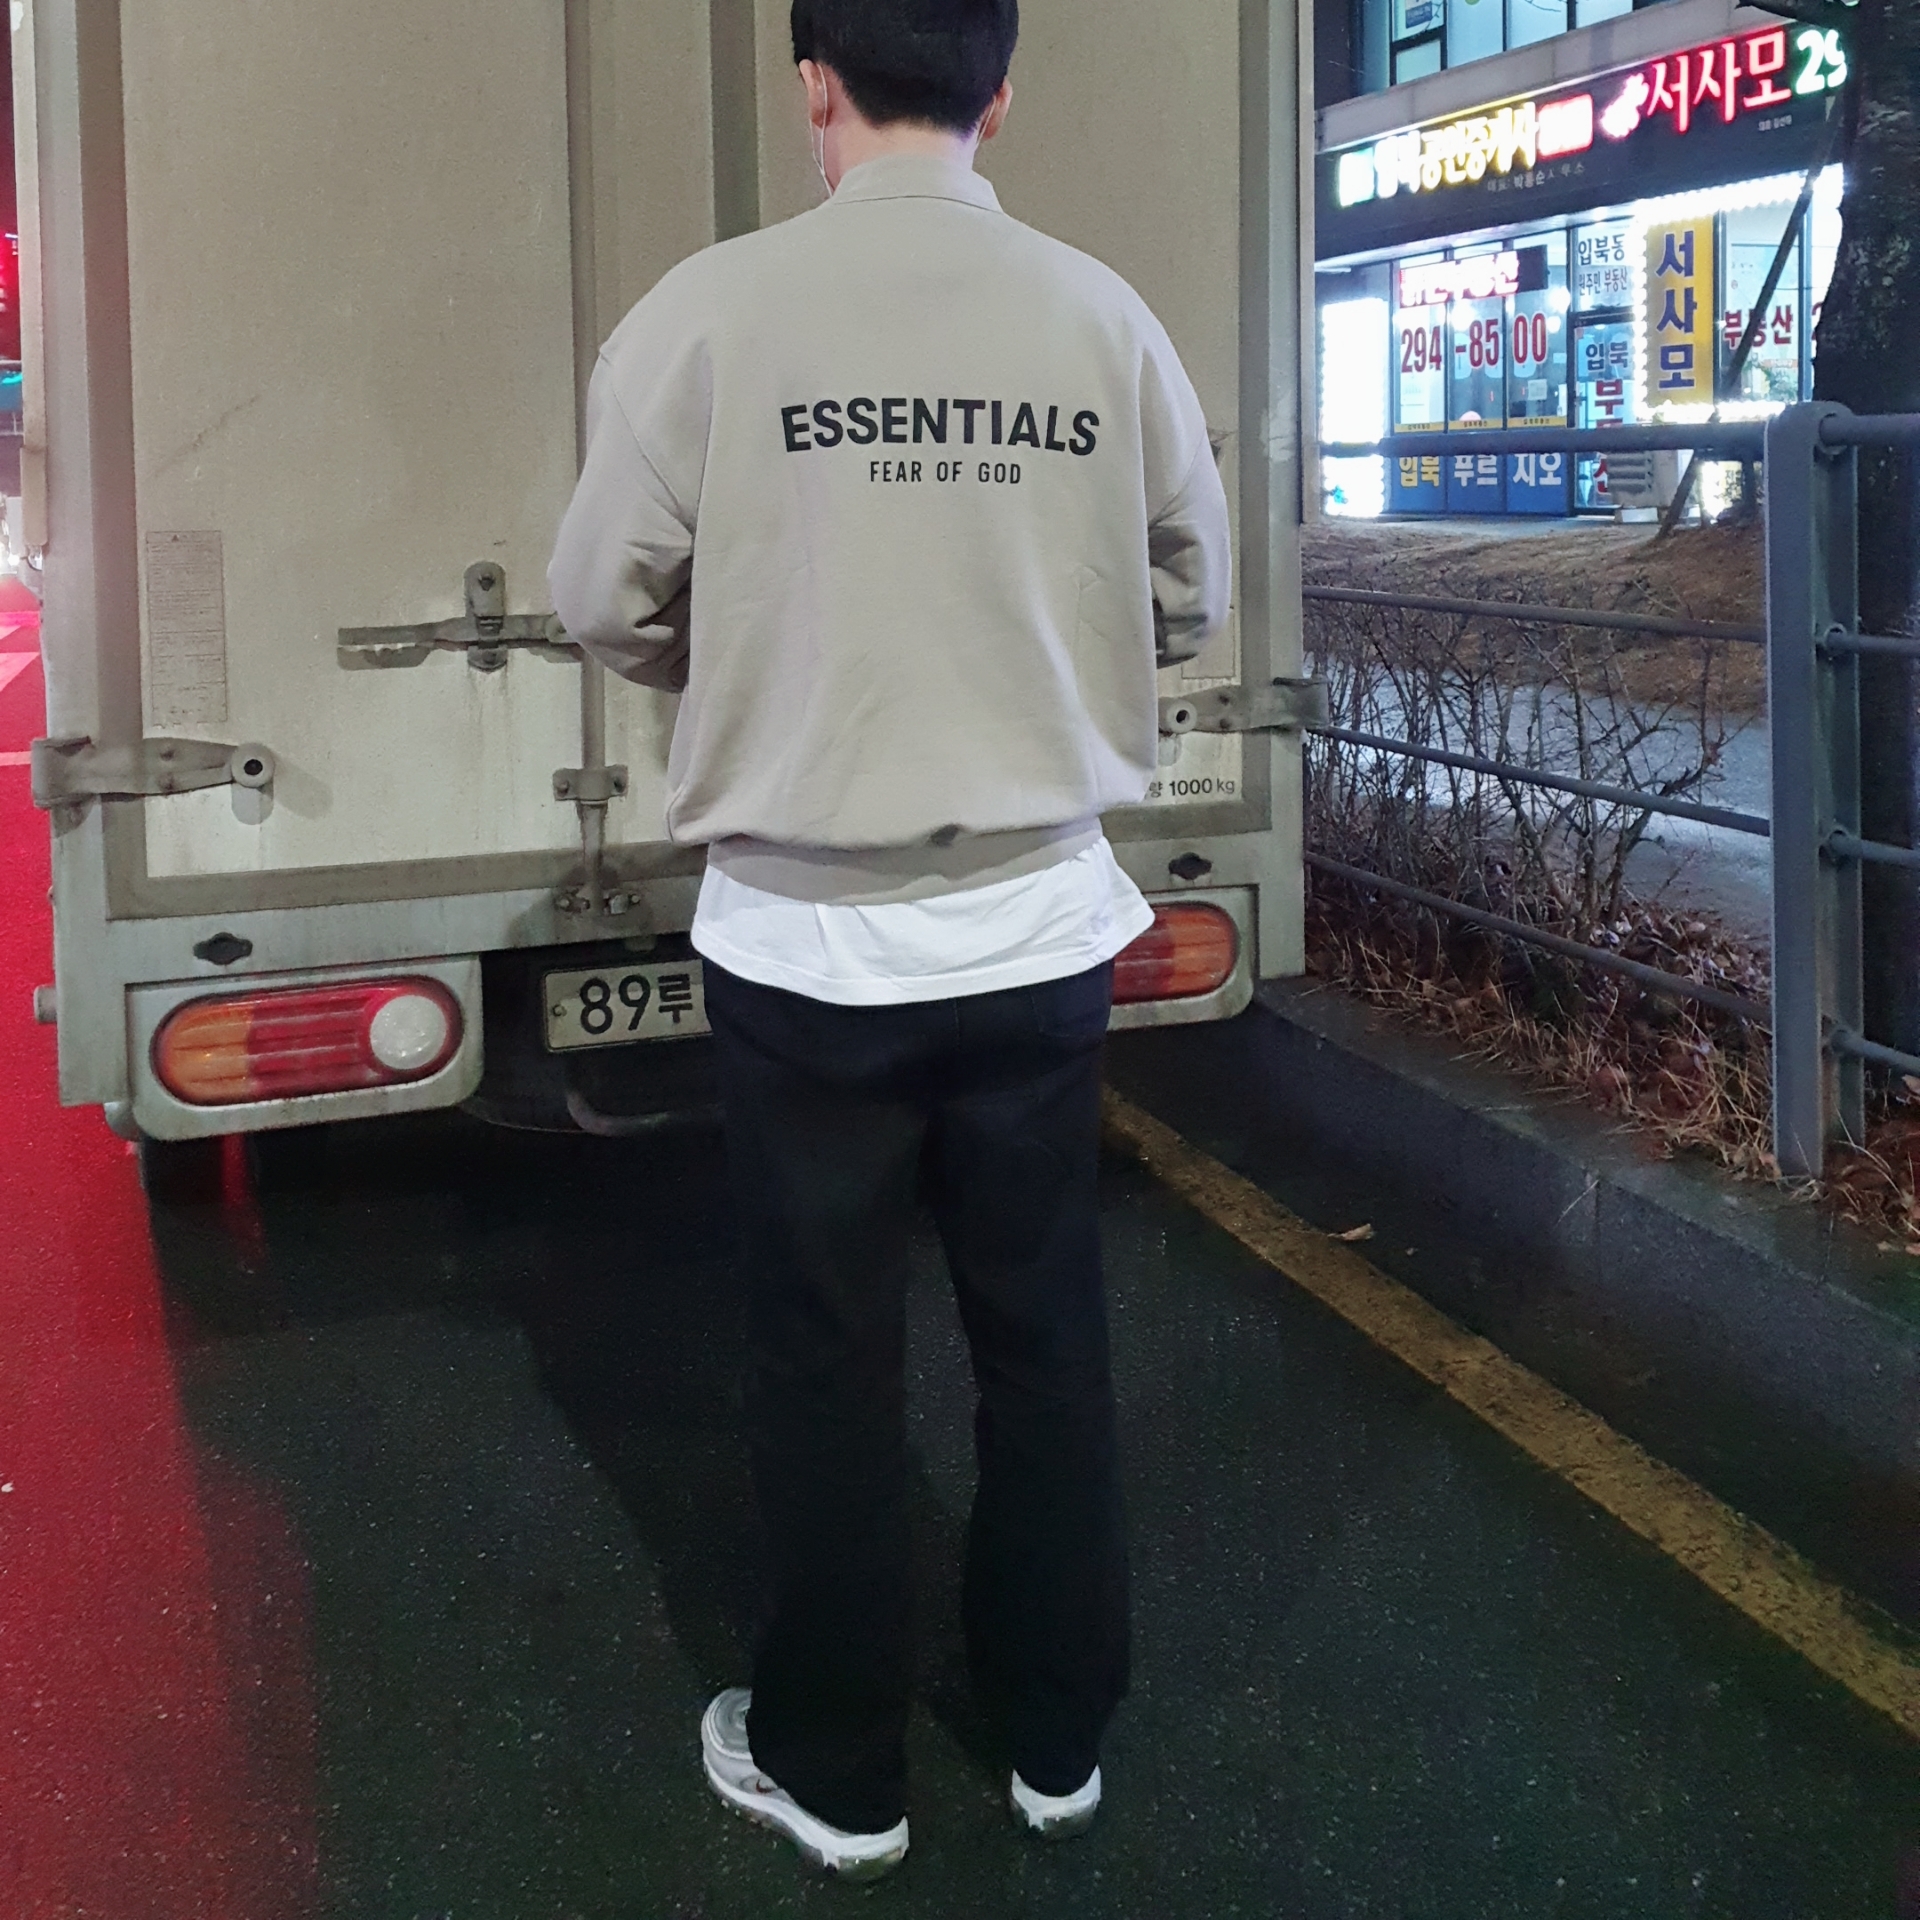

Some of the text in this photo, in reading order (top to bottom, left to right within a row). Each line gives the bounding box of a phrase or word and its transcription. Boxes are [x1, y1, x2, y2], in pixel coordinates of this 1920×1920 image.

[1647, 29, 1792, 133] 서사모
[1578, 233, 1626, 266] 입북동
[1604, 266, 1628, 292] 부동산
[1655, 230, 1698, 390] 서사모
[1585, 340, 1629, 371] 입북
[781, 397, 1100, 456] ESSENTIALS
[870, 460, 1021, 484] FEAR OF GOD
[1169, 778, 1213, 796] 1000
[1216, 778, 1236, 795] kg
[579, 973, 693, 1035] 89루
